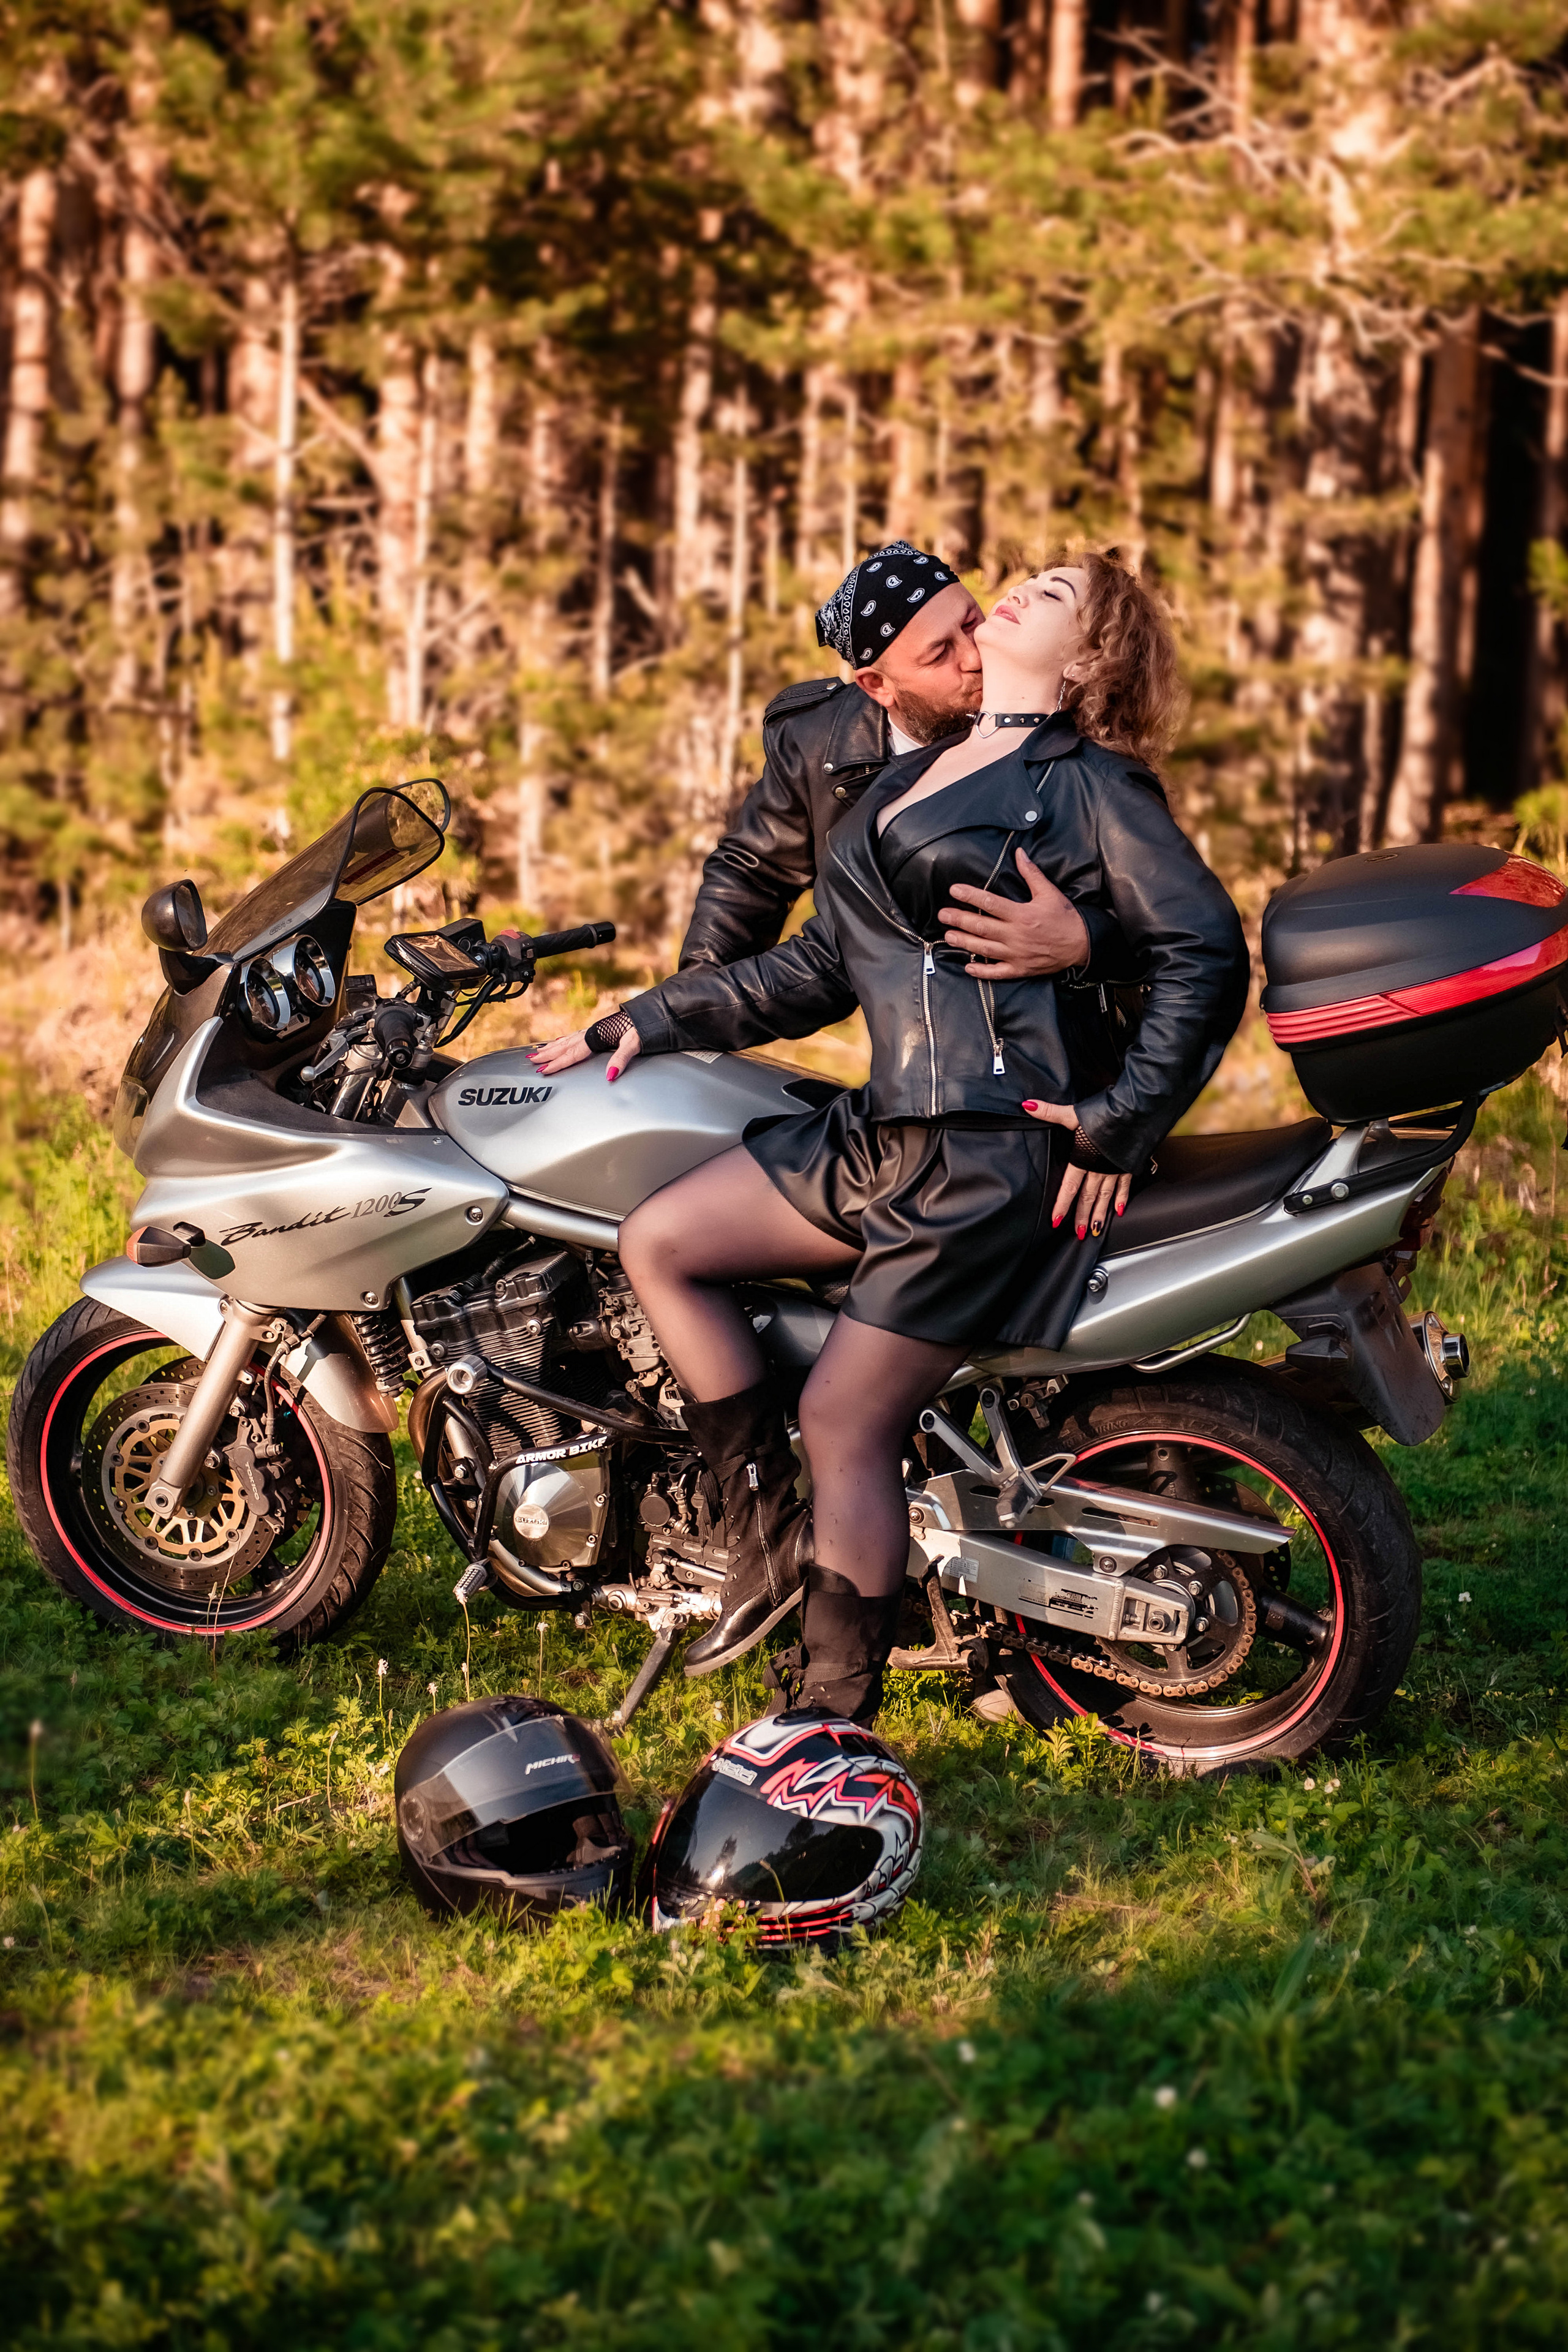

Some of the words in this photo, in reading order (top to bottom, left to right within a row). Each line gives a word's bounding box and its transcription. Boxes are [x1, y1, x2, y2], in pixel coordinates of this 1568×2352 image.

[458, 1086, 553, 1106] SUZUKI
[219, 1207, 351, 1246] Bandit
[516, 1448, 567, 1464] ARMOR
[568, 1436, 608, 1456] BIKE
[245, 1461, 260, 1500] TOKICO
[515, 1516, 547, 1525] SUZUKI
